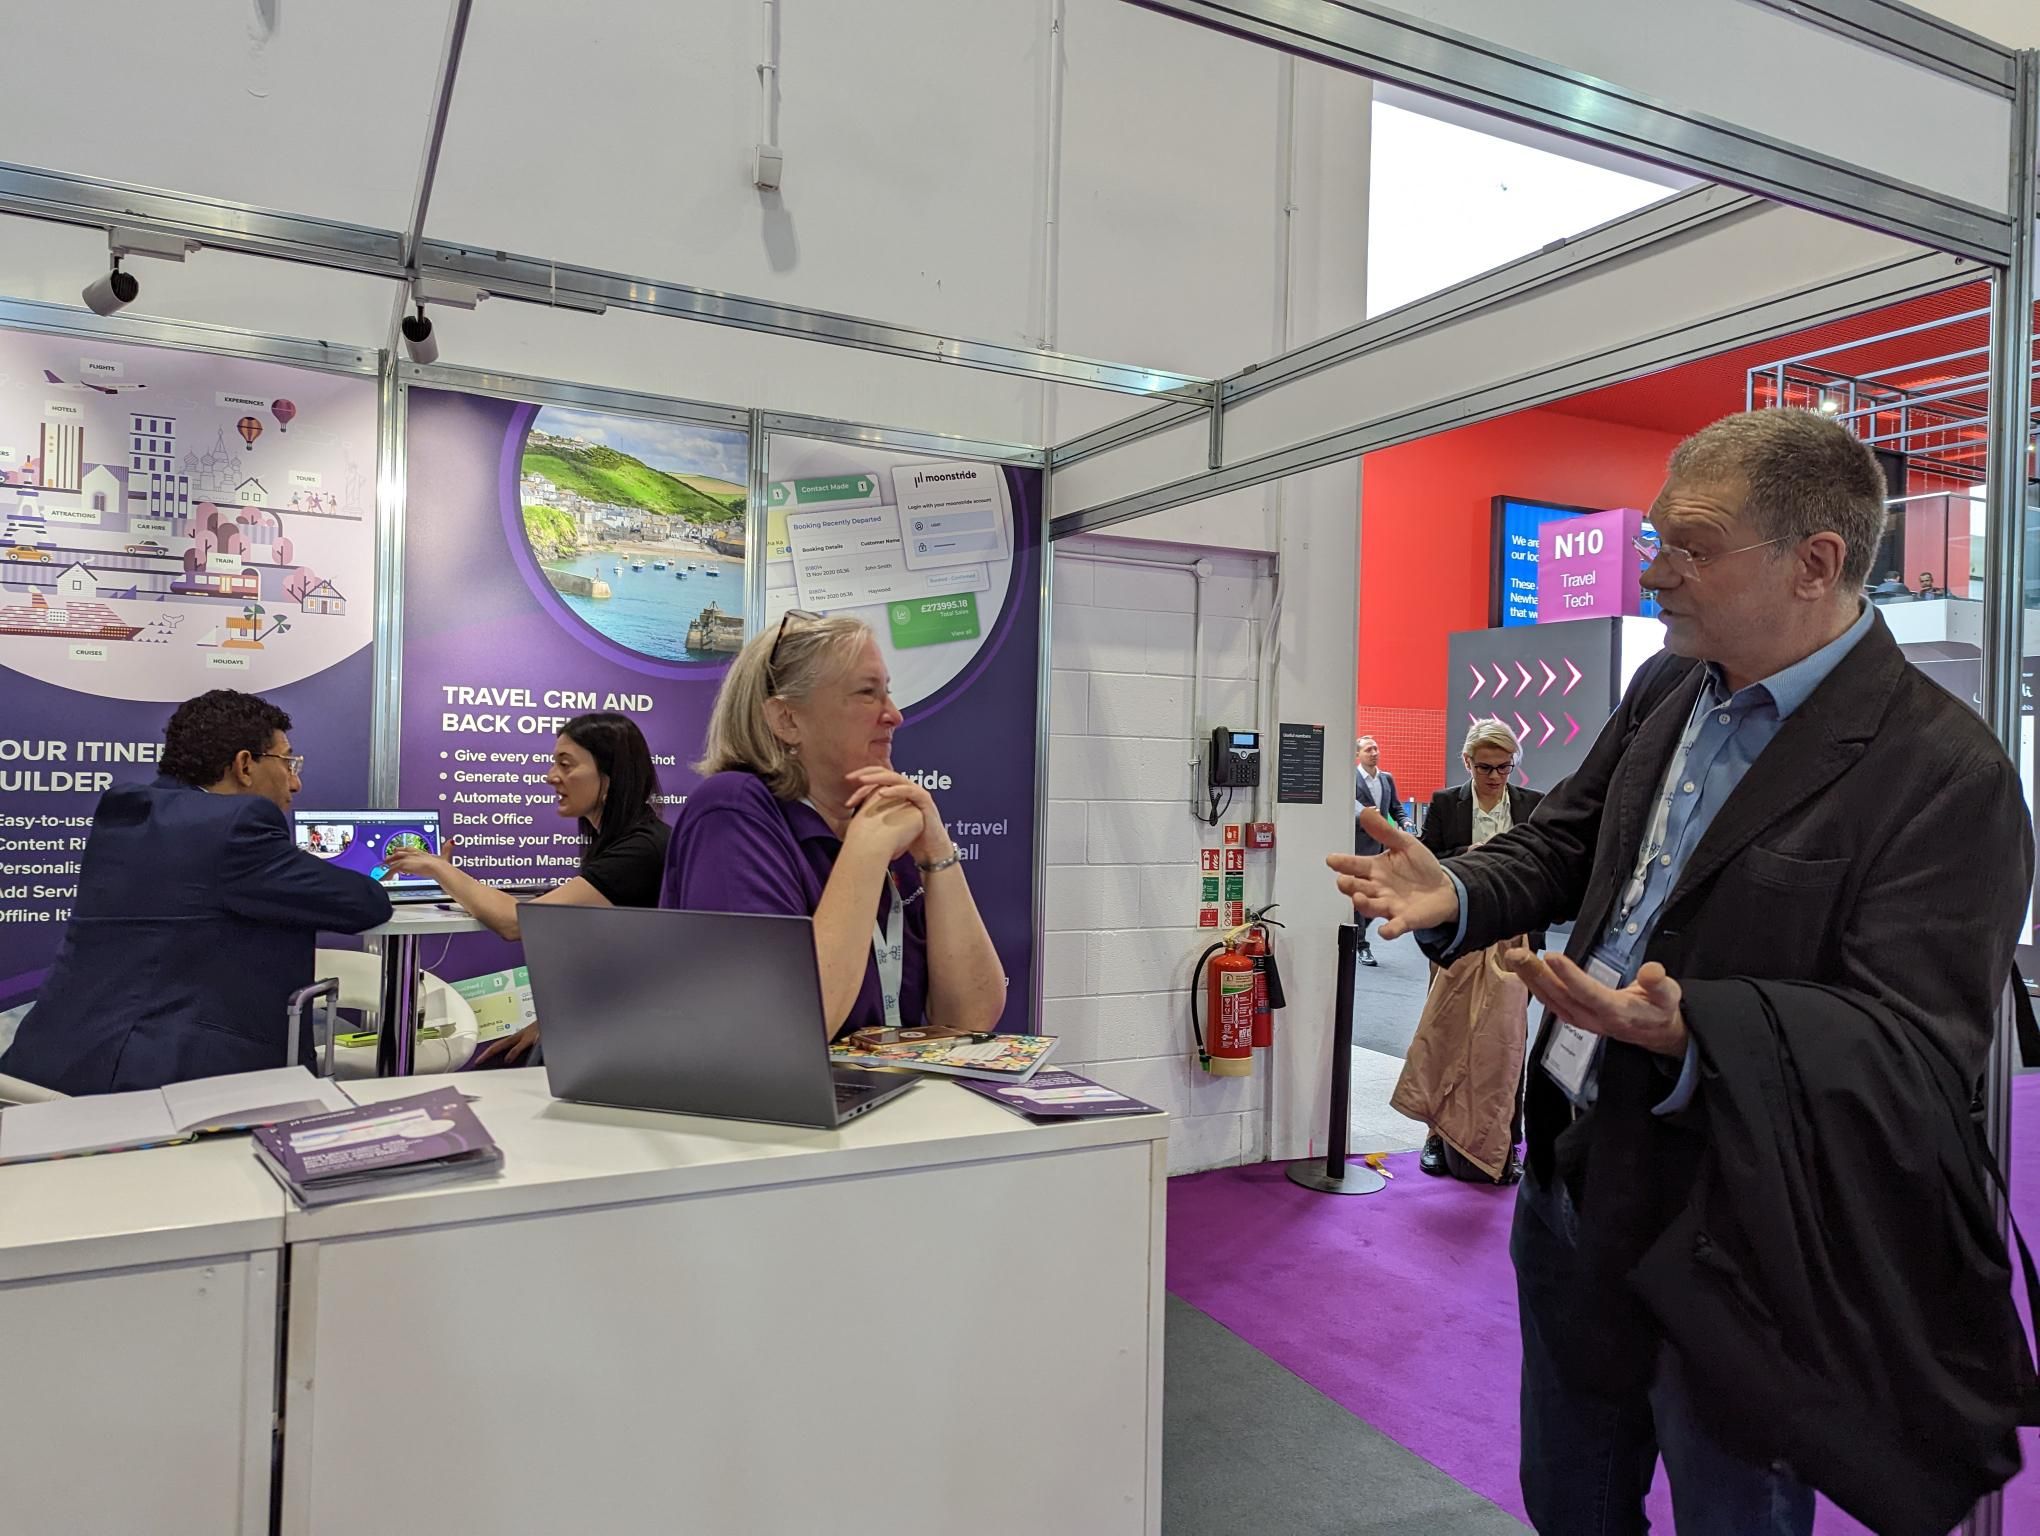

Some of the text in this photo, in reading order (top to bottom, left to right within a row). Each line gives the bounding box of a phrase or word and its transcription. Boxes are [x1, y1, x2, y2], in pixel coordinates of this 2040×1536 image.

[89, 364, 115, 372] FLIGHTS
[52, 406, 77, 414] HOTELS
[296, 475, 316, 483] TOURS
[925, 471, 977, 482] moonstride
[801, 485, 829, 493] Contact
[830, 483, 850, 491] Made
[51, 511, 96, 520] ATTRACTIONS
[793, 516, 882, 531] Booking Recently Departed
[1511, 534, 1527, 546] We
[1555, 528, 1604, 560] N10
[215, 557, 234, 565] TRAIN
[1511, 551, 1527, 560] our
[1510, 577, 1535, 590] These
[1560, 570, 1596, 588] Travel
[921, 600, 968, 613] £273995.18
[1562, 592, 1594, 608] Tech
[1510, 607, 1527, 618] that
[76, 649, 103, 657] CRUISES
[213, 658, 244, 666] HOLIDAYS
[442, 686, 653, 712] TRAVEL CRM AND
[442, 713, 571, 734] BACK OFF
[0, 739, 67, 761] OUR
[454, 750, 487, 762] Give
[490, 752, 529, 765] every
[454, 770, 520, 783] Generate
[453, 792, 522, 804] Automate
[525, 794, 556, 806] your
[453, 813, 488, 825] Back
[491, 813, 534, 825] Office
[957, 819, 1008, 836] travel
[69, 837, 87, 851] Ri
[453, 834, 516, 848] Optimise
[519, 836, 550, 848] your
[452, 855, 582, 868] Distribution Manag
[33, 884, 78, 898] Servi
